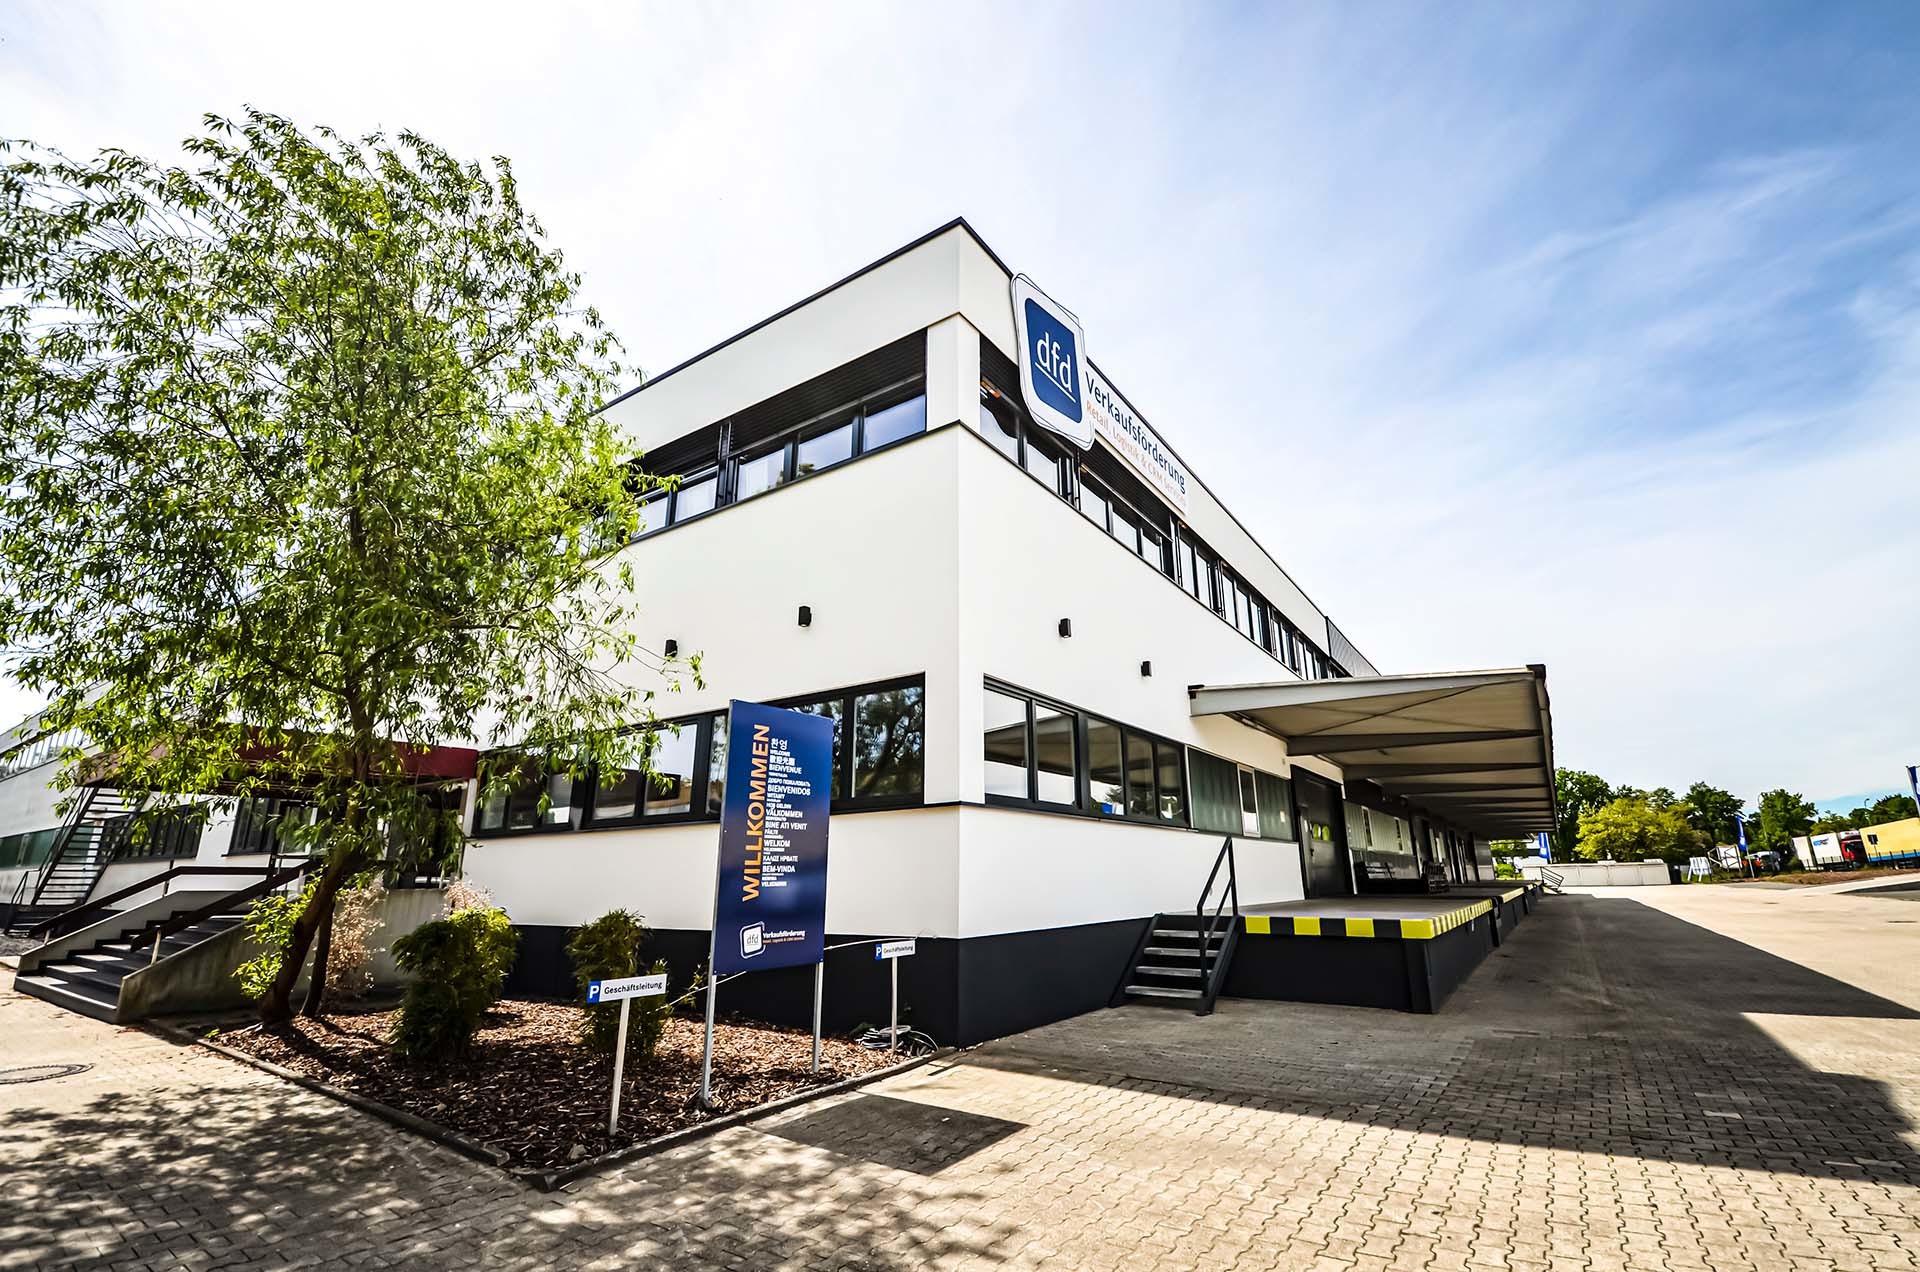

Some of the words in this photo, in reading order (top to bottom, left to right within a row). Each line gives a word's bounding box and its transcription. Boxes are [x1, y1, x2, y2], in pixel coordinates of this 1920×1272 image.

[1036, 332, 1073, 393] dfd
[1085, 371, 1185, 494] Verkaufsförderung
[769, 764, 802, 774] BIENVENUE
[767, 784, 811, 796] BIENVENIDOS
[742, 723, 770, 902] WILLKOMMEN
[790, 822, 807, 830] VENIT
[763, 840, 790, 848] WELKOM
[762, 865, 795, 873] BEM-VINDA
[746, 933, 759, 945] dfd
[876, 946, 882, 957] P
[589, 985, 600, 999] P
[604, 981, 662, 995] Geschäftsleitung
